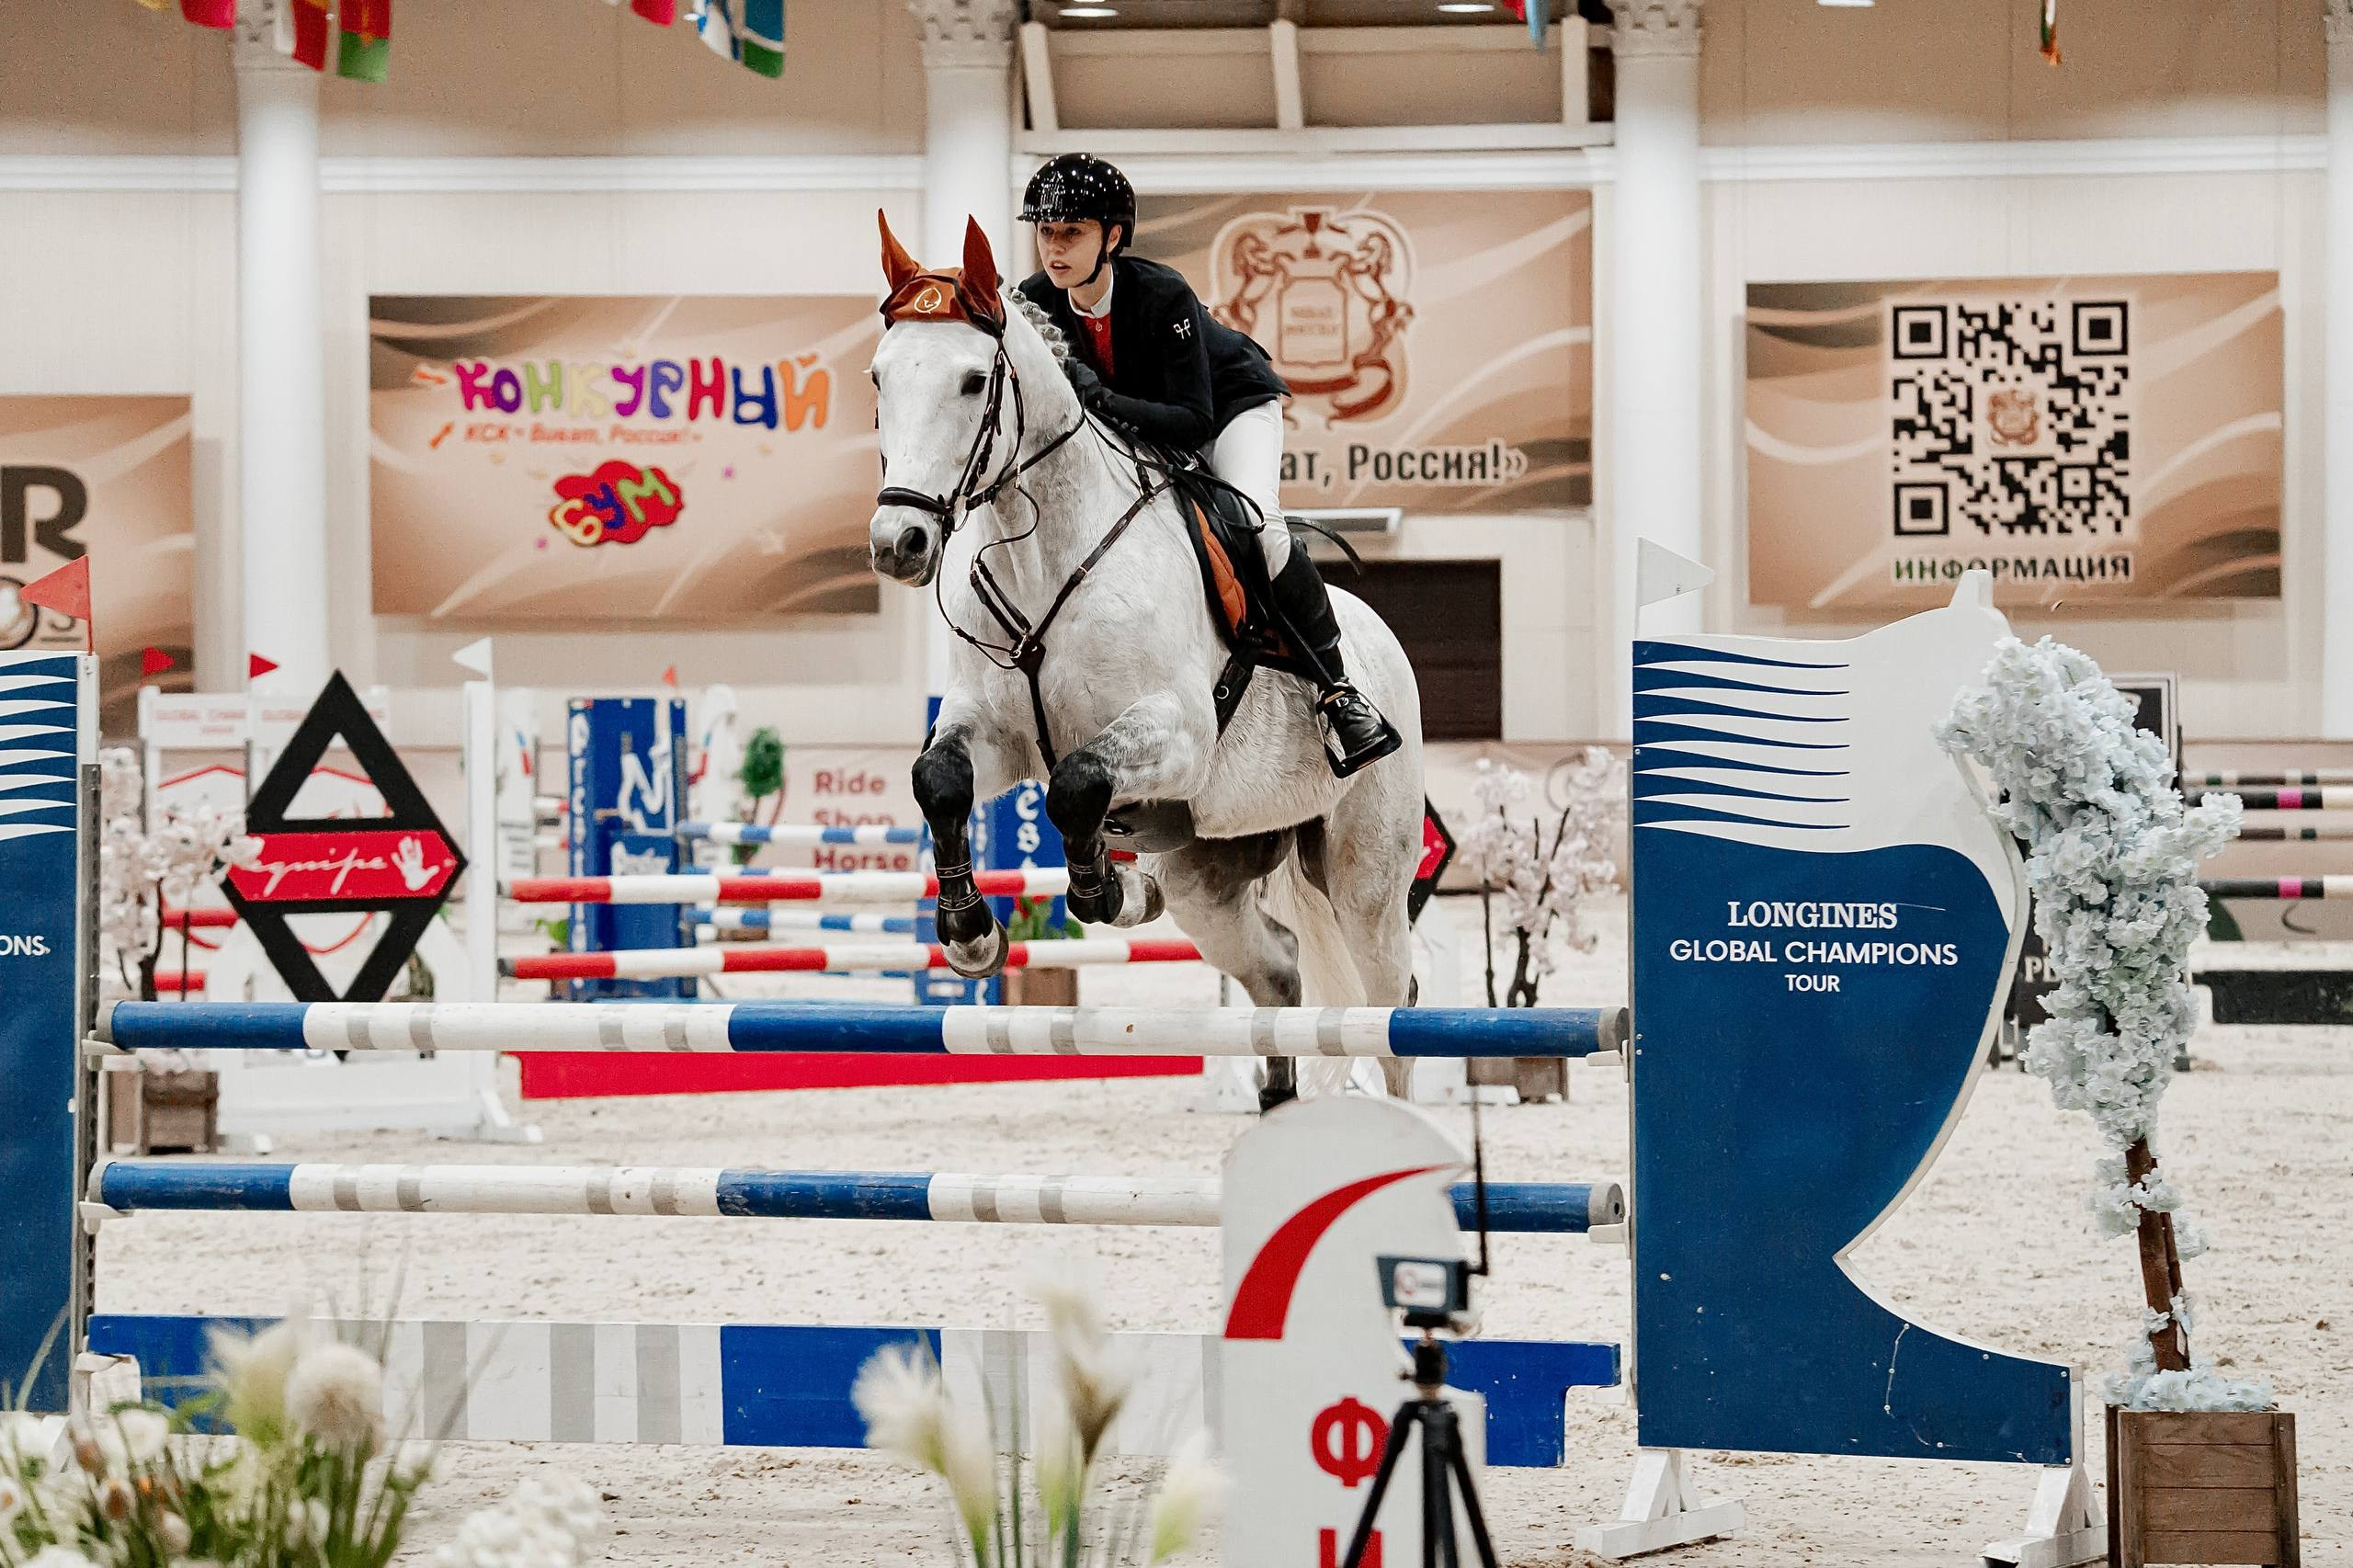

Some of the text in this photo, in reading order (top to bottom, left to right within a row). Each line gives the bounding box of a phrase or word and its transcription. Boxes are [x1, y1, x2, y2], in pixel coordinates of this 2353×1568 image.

[457, 354, 829, 432] КОНКУРНЫЙ
[553, 467, 675, 546] БУМ
[1895, 555, 2131, 581] ИНФОРМАЦИЯ
[814, 771, 887, 795] Ride
[813, 848, 909, 871] Horse
[1727, 900, 1898, 930] LONGINES
[1669, 939, 1959, 966] GLOBAL CHAMPIONS
[1784, 973, 1840, 993] TOUR
